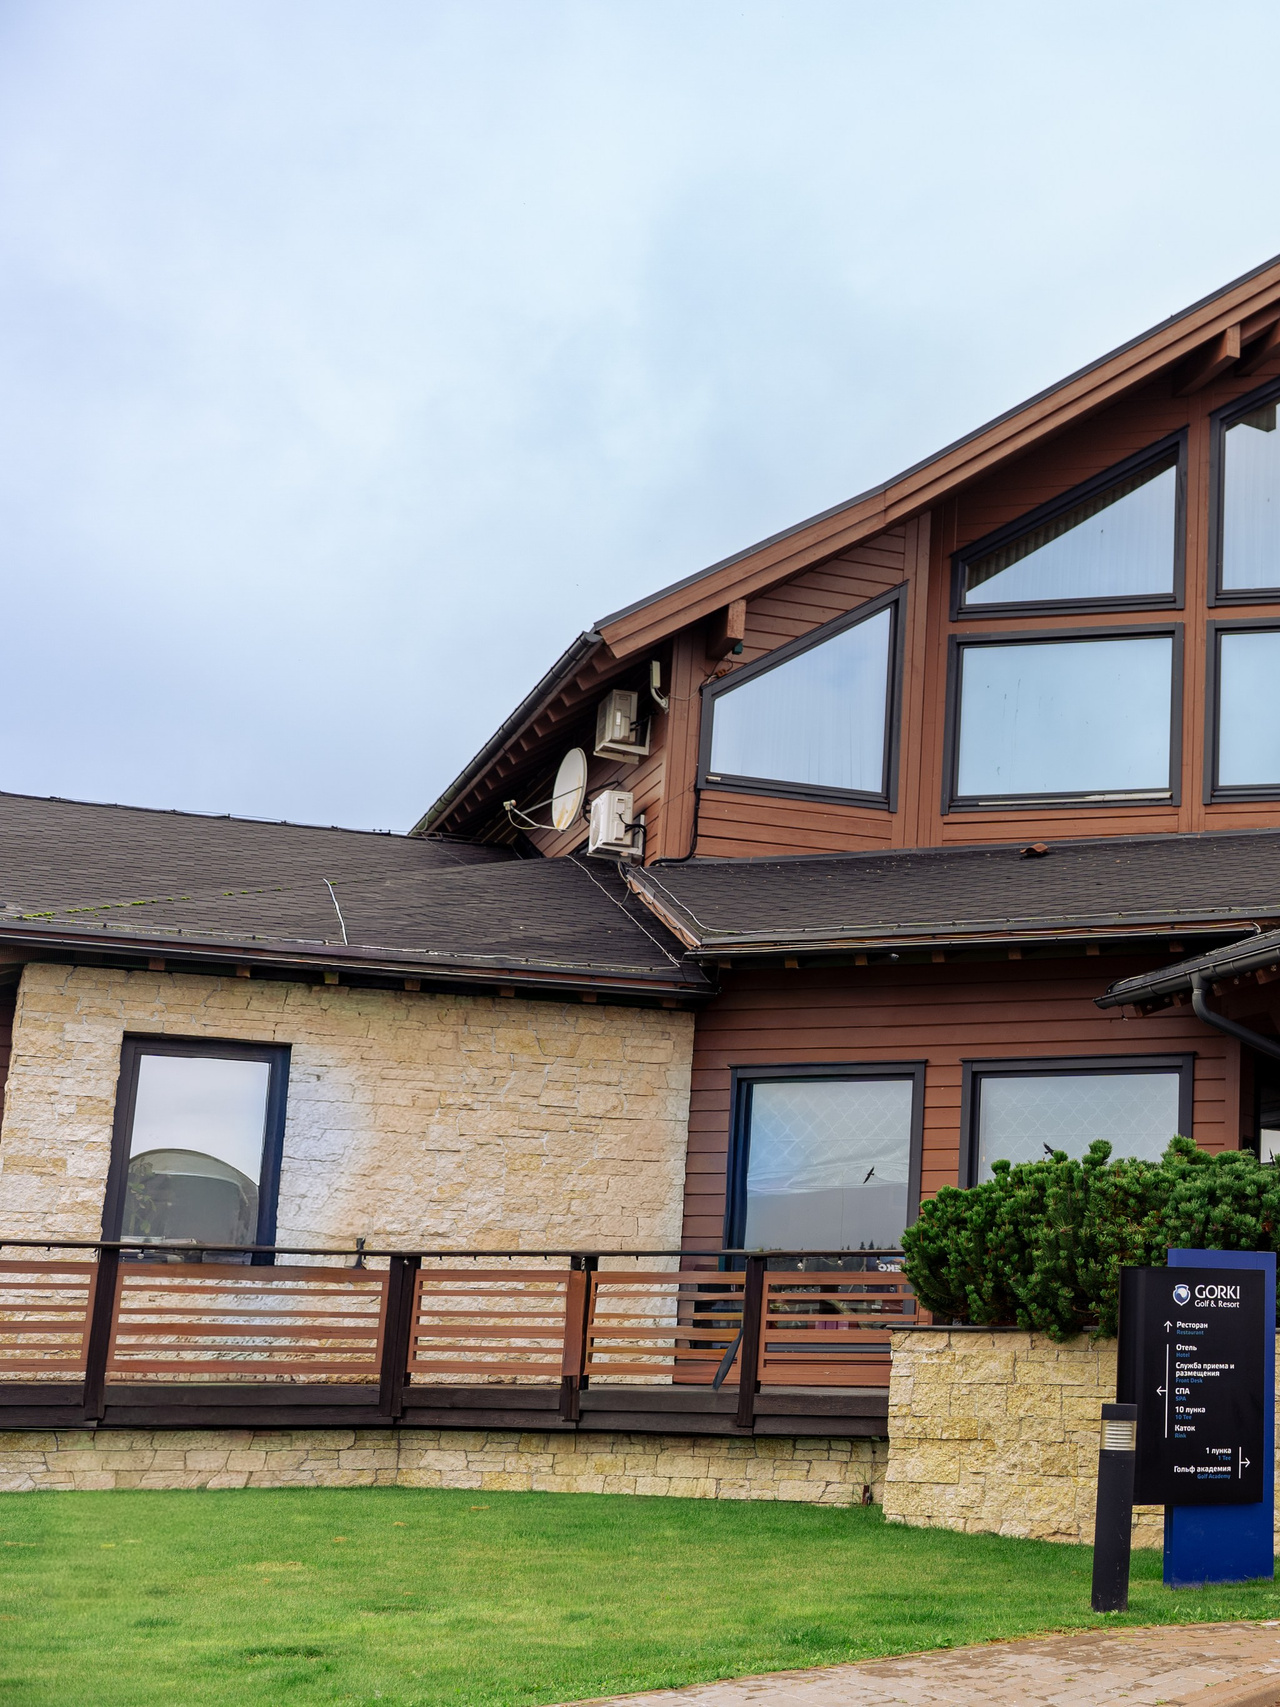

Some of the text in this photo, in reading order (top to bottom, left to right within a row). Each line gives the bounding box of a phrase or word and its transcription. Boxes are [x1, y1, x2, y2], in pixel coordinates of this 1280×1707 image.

[1195, 1284, 1240, 1299] GORKI
[1218, 1300, 1240, 1308] Resort
[1176, 1321, 1208, 1329] Ресторан
[1176, 1343, 1197, 1351] Отель
[1175, 1361, 1202, 1370] Служба
[1175, 1370, 1220, 1378] размещения
[1175, 1387, 1190, 1395] СПА
[1174, 1424, 1196, 1432] Каток
[1173, 1465, 1196, 1474] Гольф
